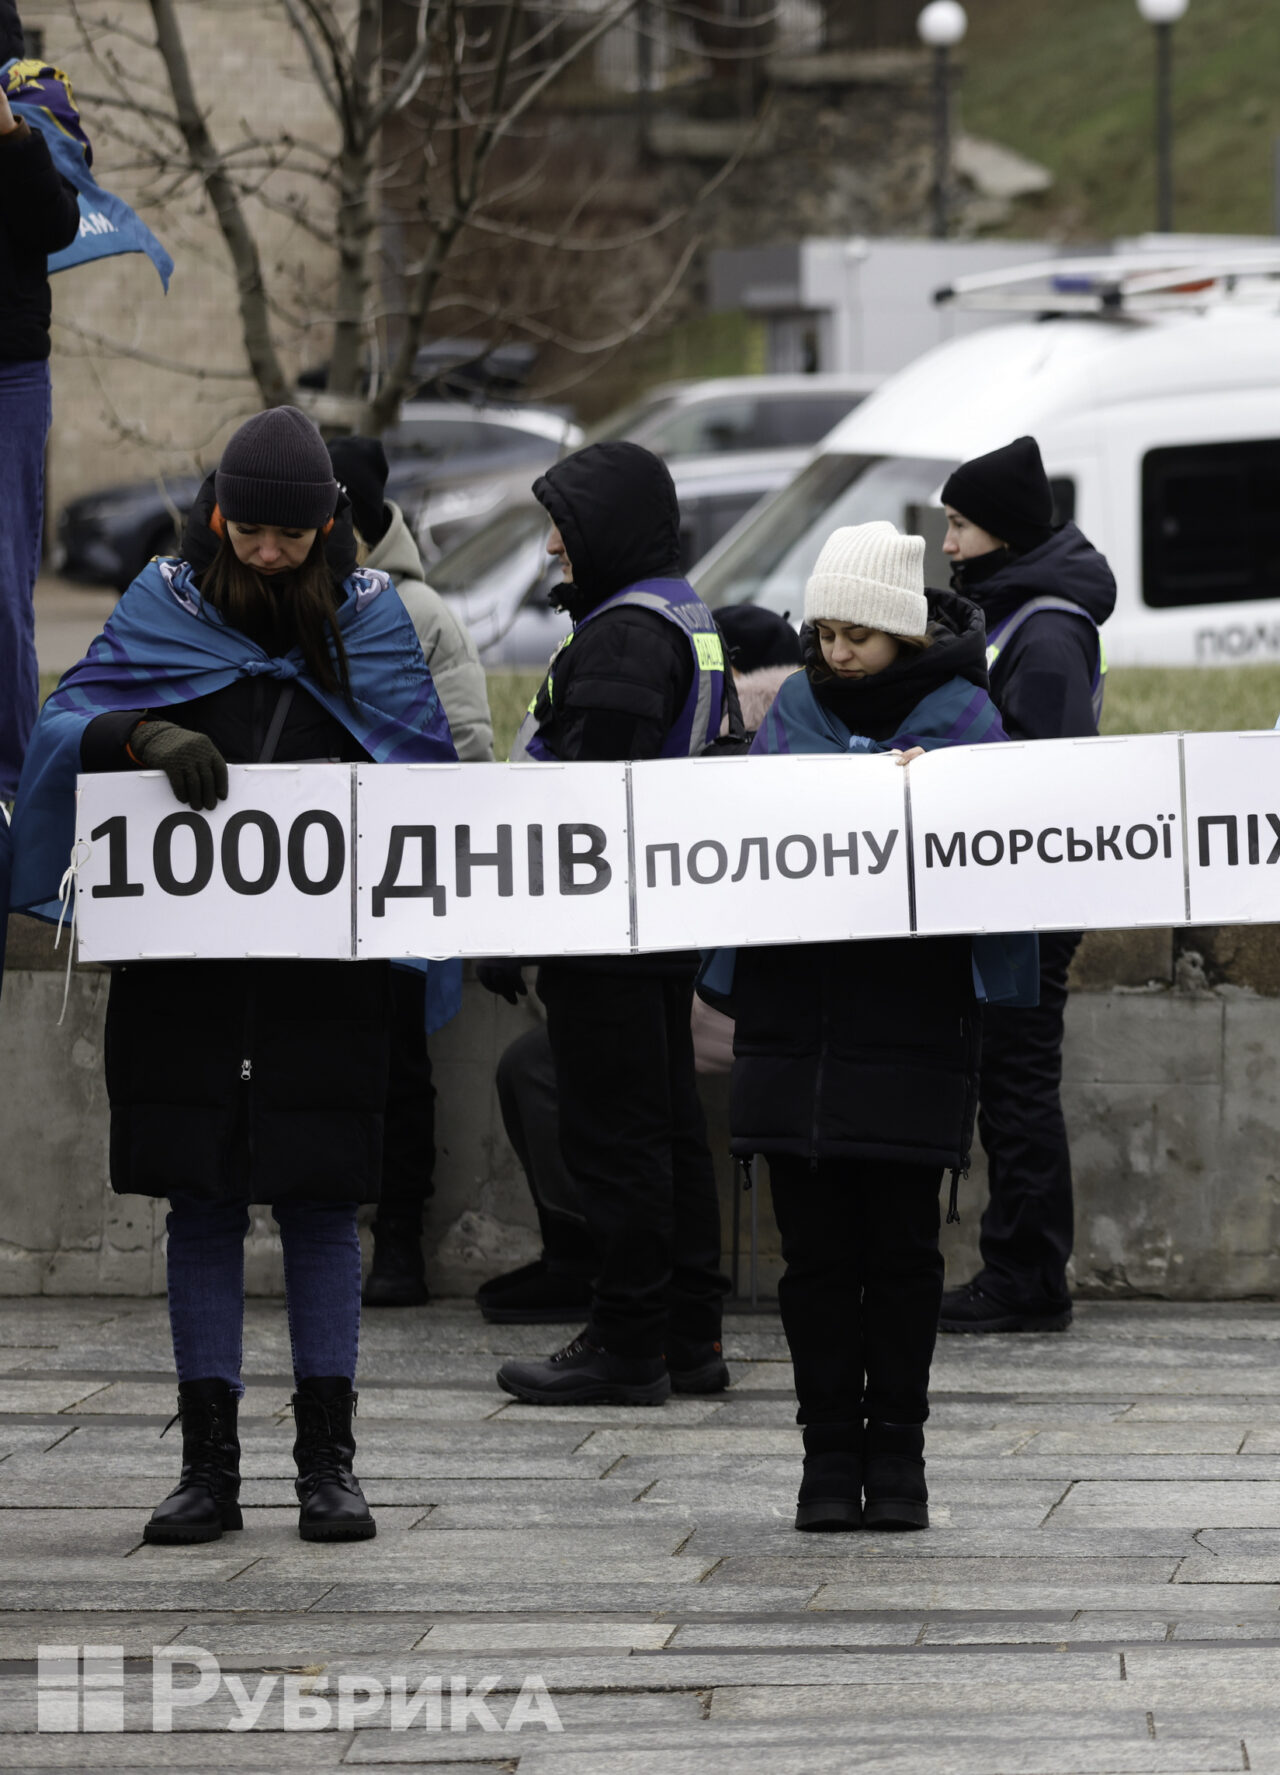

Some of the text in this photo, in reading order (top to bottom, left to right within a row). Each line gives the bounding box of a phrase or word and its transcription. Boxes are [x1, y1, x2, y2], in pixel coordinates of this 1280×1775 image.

[91, 809, 346, 899] 1000
[372, 823, 612, 918] ДНІВ
[646, 830, 899, 888] ПОЛОНУ
[925, 813, 1176, 869] МОРСЬКОЇ
